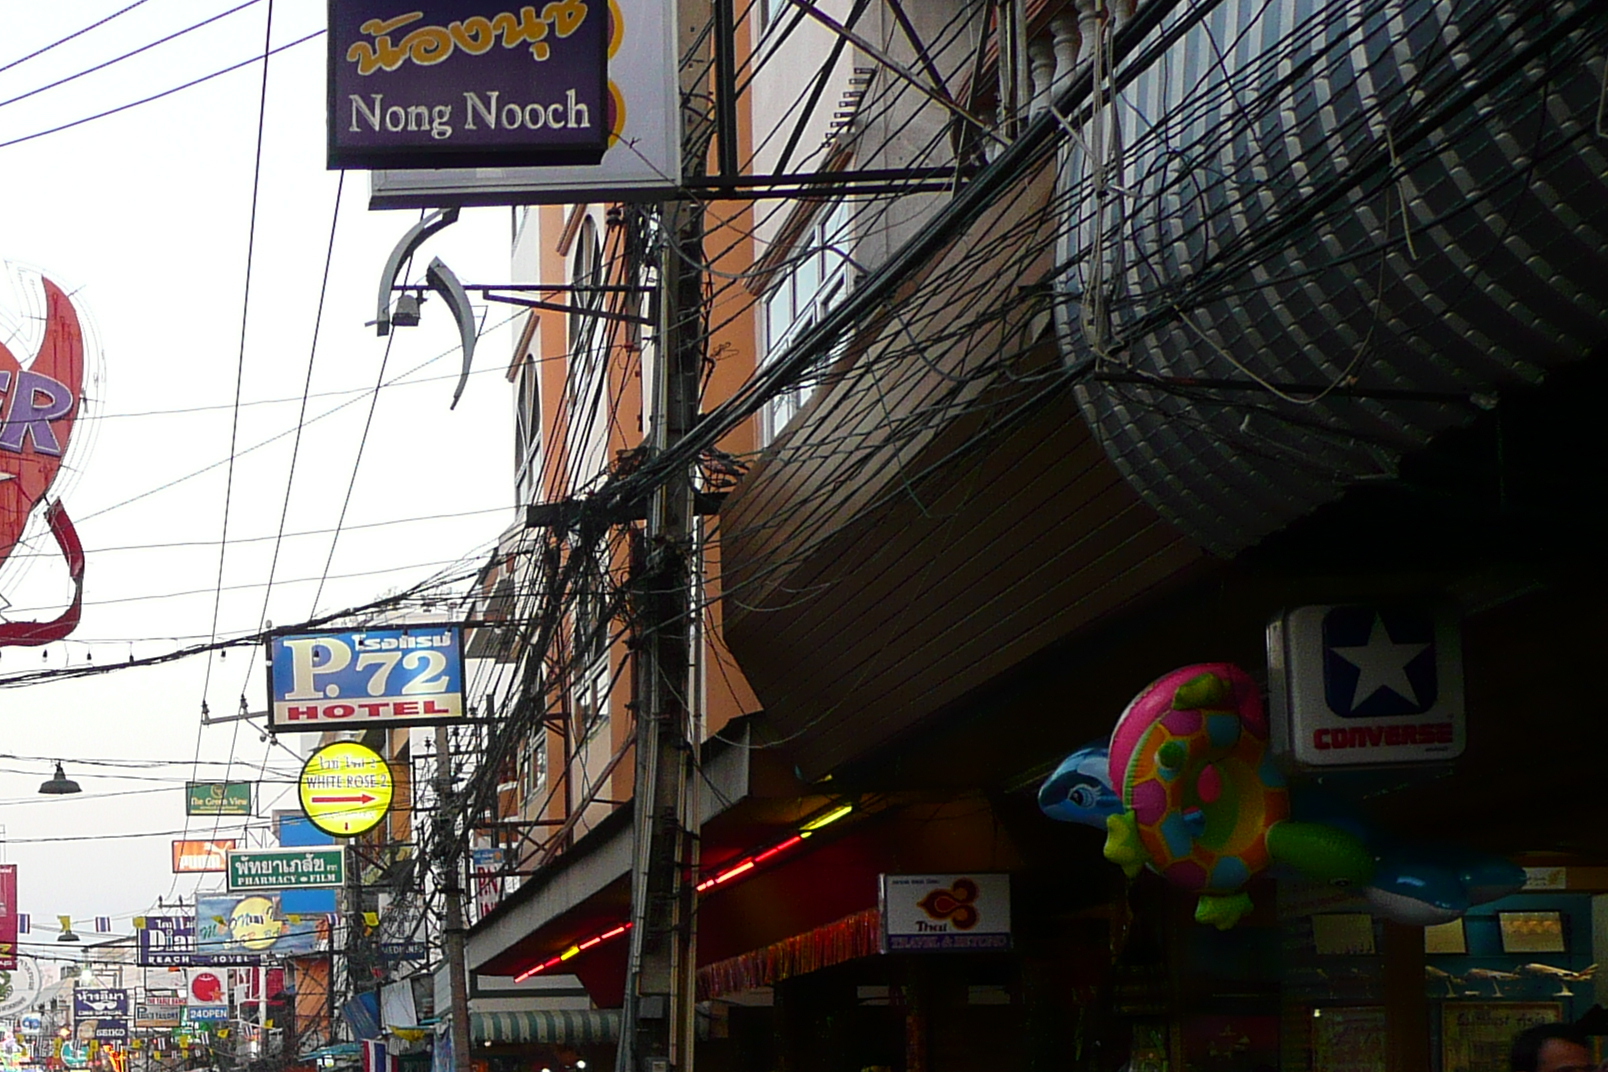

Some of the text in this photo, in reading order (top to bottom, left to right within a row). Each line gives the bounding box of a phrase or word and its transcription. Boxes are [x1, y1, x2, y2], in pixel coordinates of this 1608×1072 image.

[349, 88, 592, 140] Nong Nooch
[287, 700, 450, 721] HOTEL
[1312, 722, 1454, 751] CONVERSE
[306, 775, 342, 788] WHITE
[347, 775, 376, 788] ROSE
[237, 873, 335, 886] PHARMACY FILM
[916, 921, 947, 932] Thai
[96, 1028, 125, 1036] SEIKO
